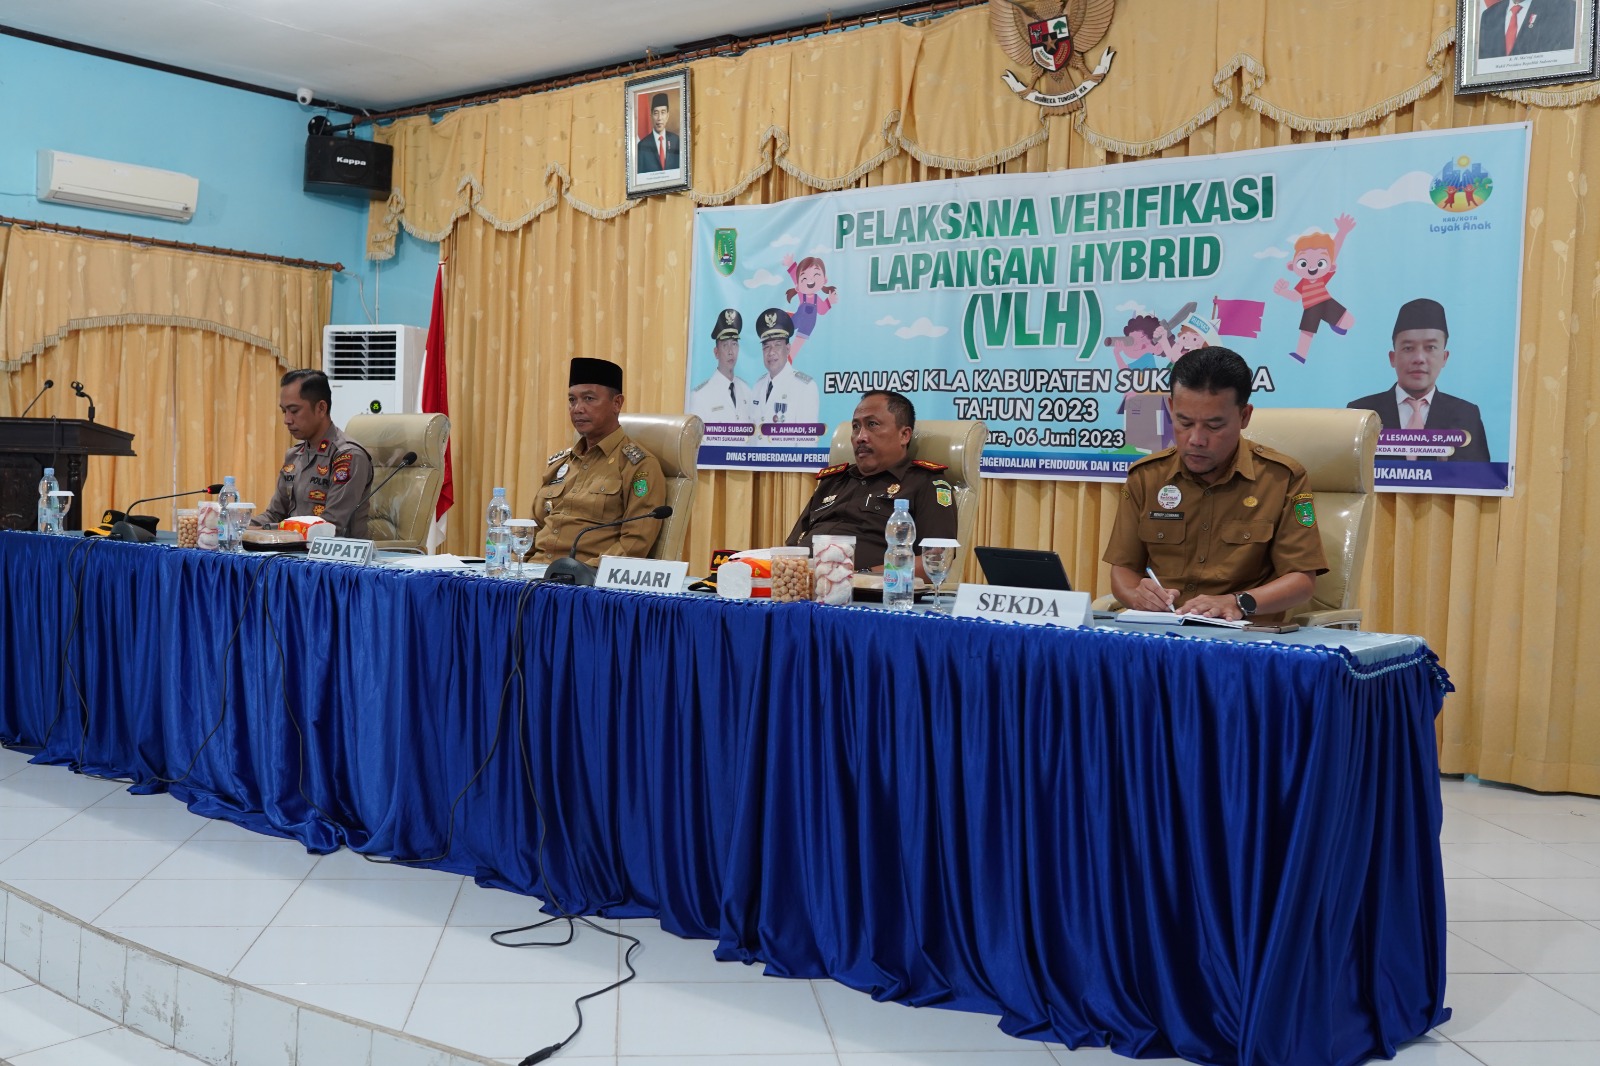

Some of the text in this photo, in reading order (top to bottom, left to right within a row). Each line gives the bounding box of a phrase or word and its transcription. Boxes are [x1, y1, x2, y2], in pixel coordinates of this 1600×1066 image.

[336, 156, 367, 166] Kappa
[835, 175, 1275, 250] PELAKSANA VERIFIKASI
[1462, 220, 1492, 231] Anak
[869, 235, 1221, 293] LAPANGAN HYBRID
[962, 289, 1103, 361] (VLH)
[824, 370, 919, 393] EVALUASI
[923, 369, 969, 392] KLA
[972, 368, 1112, 393] KABUPATEN
[953, 397, 1099, 422] TAHUN 2023
[1014, 427, 1038, 446] 06
[1040, 428, 1077, 447] Juni
[1079, 429, 1126, 448] 2023
[1386, 434, 1430, 443] LESMANA,
[726, 451, 747, 461] DINAS
[747, 452, 803, 463] PEMBERDAYAAN
[803, 453, 830, 463] PEREM
[980, 456, 1037, 469] ENGENDALIAN
[1038, 459, 1089, 471] PENDUDUK
[1090, 460, 1110, 472] DAN
[1374, 467, 1433, 480] UKAMARA
[310, 541, 368, 559] BUPATI
[606, 568, 672, 588] KAJARI
[976, 592, 1060, 618] SEKDA
